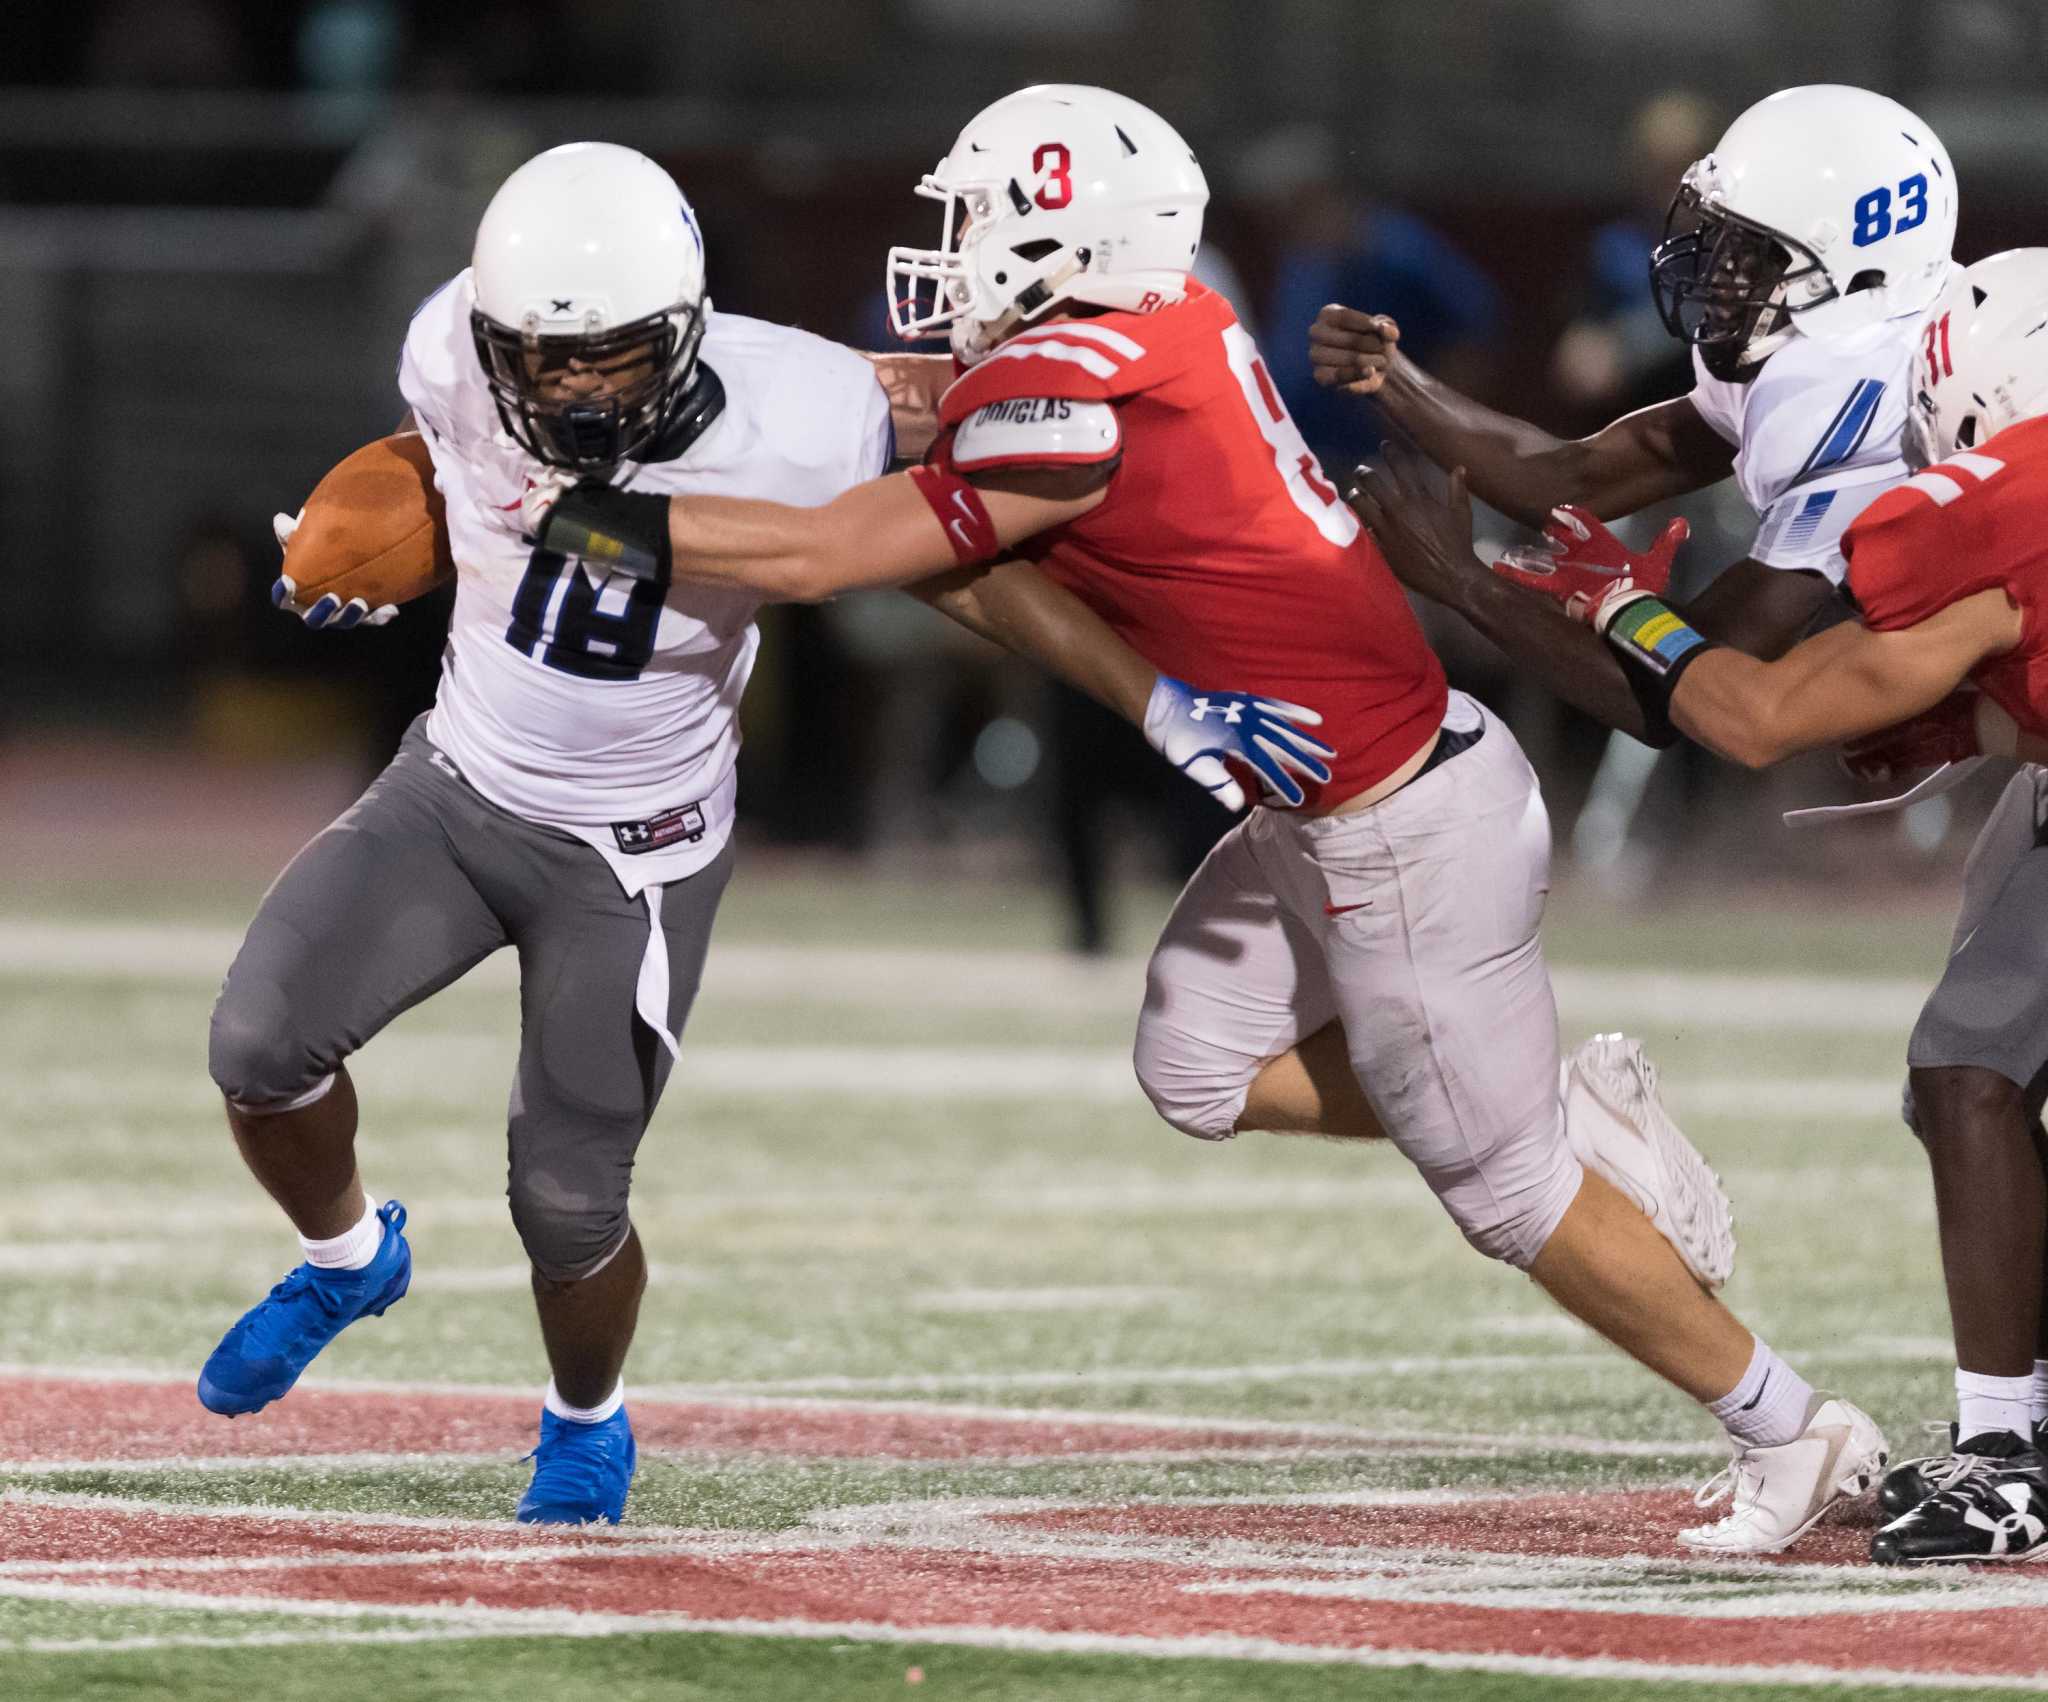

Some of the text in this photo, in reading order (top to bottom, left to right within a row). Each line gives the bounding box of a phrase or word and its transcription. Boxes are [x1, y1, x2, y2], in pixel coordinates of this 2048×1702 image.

[1032, 142, 1072, 210] 3
[1852, 172, 1928, 248] 83
[1920, 311, 1953, 386] 31
[505, 548, 667, 681] 18
